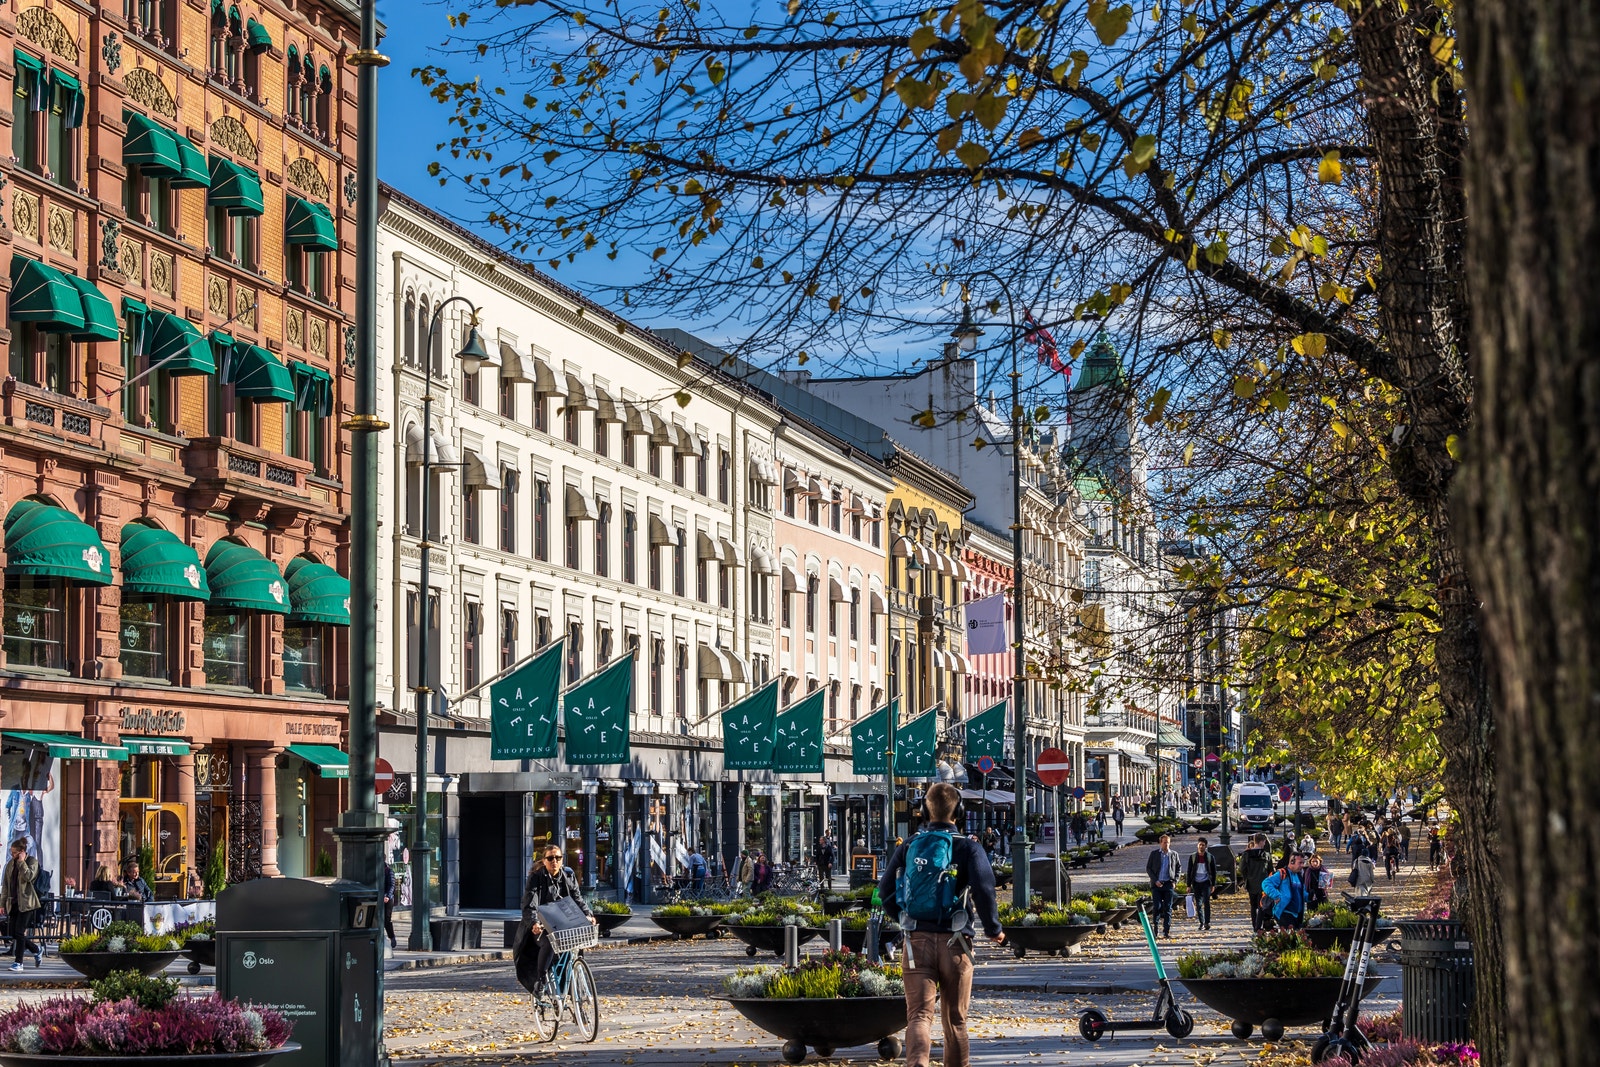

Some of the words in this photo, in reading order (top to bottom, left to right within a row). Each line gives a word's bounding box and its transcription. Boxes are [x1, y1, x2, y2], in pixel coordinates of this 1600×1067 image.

[122, 706, 144, 729] Hard
[146, 708, 165, 734] Rock
[166, 710, 185, 732] Cafe
[286, 722, 302, 734] DALE
[303, 724, 311, 735] OF
[312, 724, 338, 736] NORWAY
[71, 748, 79, 756] LOVE
[89, 748, 100, 758] SERVE
[1359, 951, 1368, 976] BIRD
